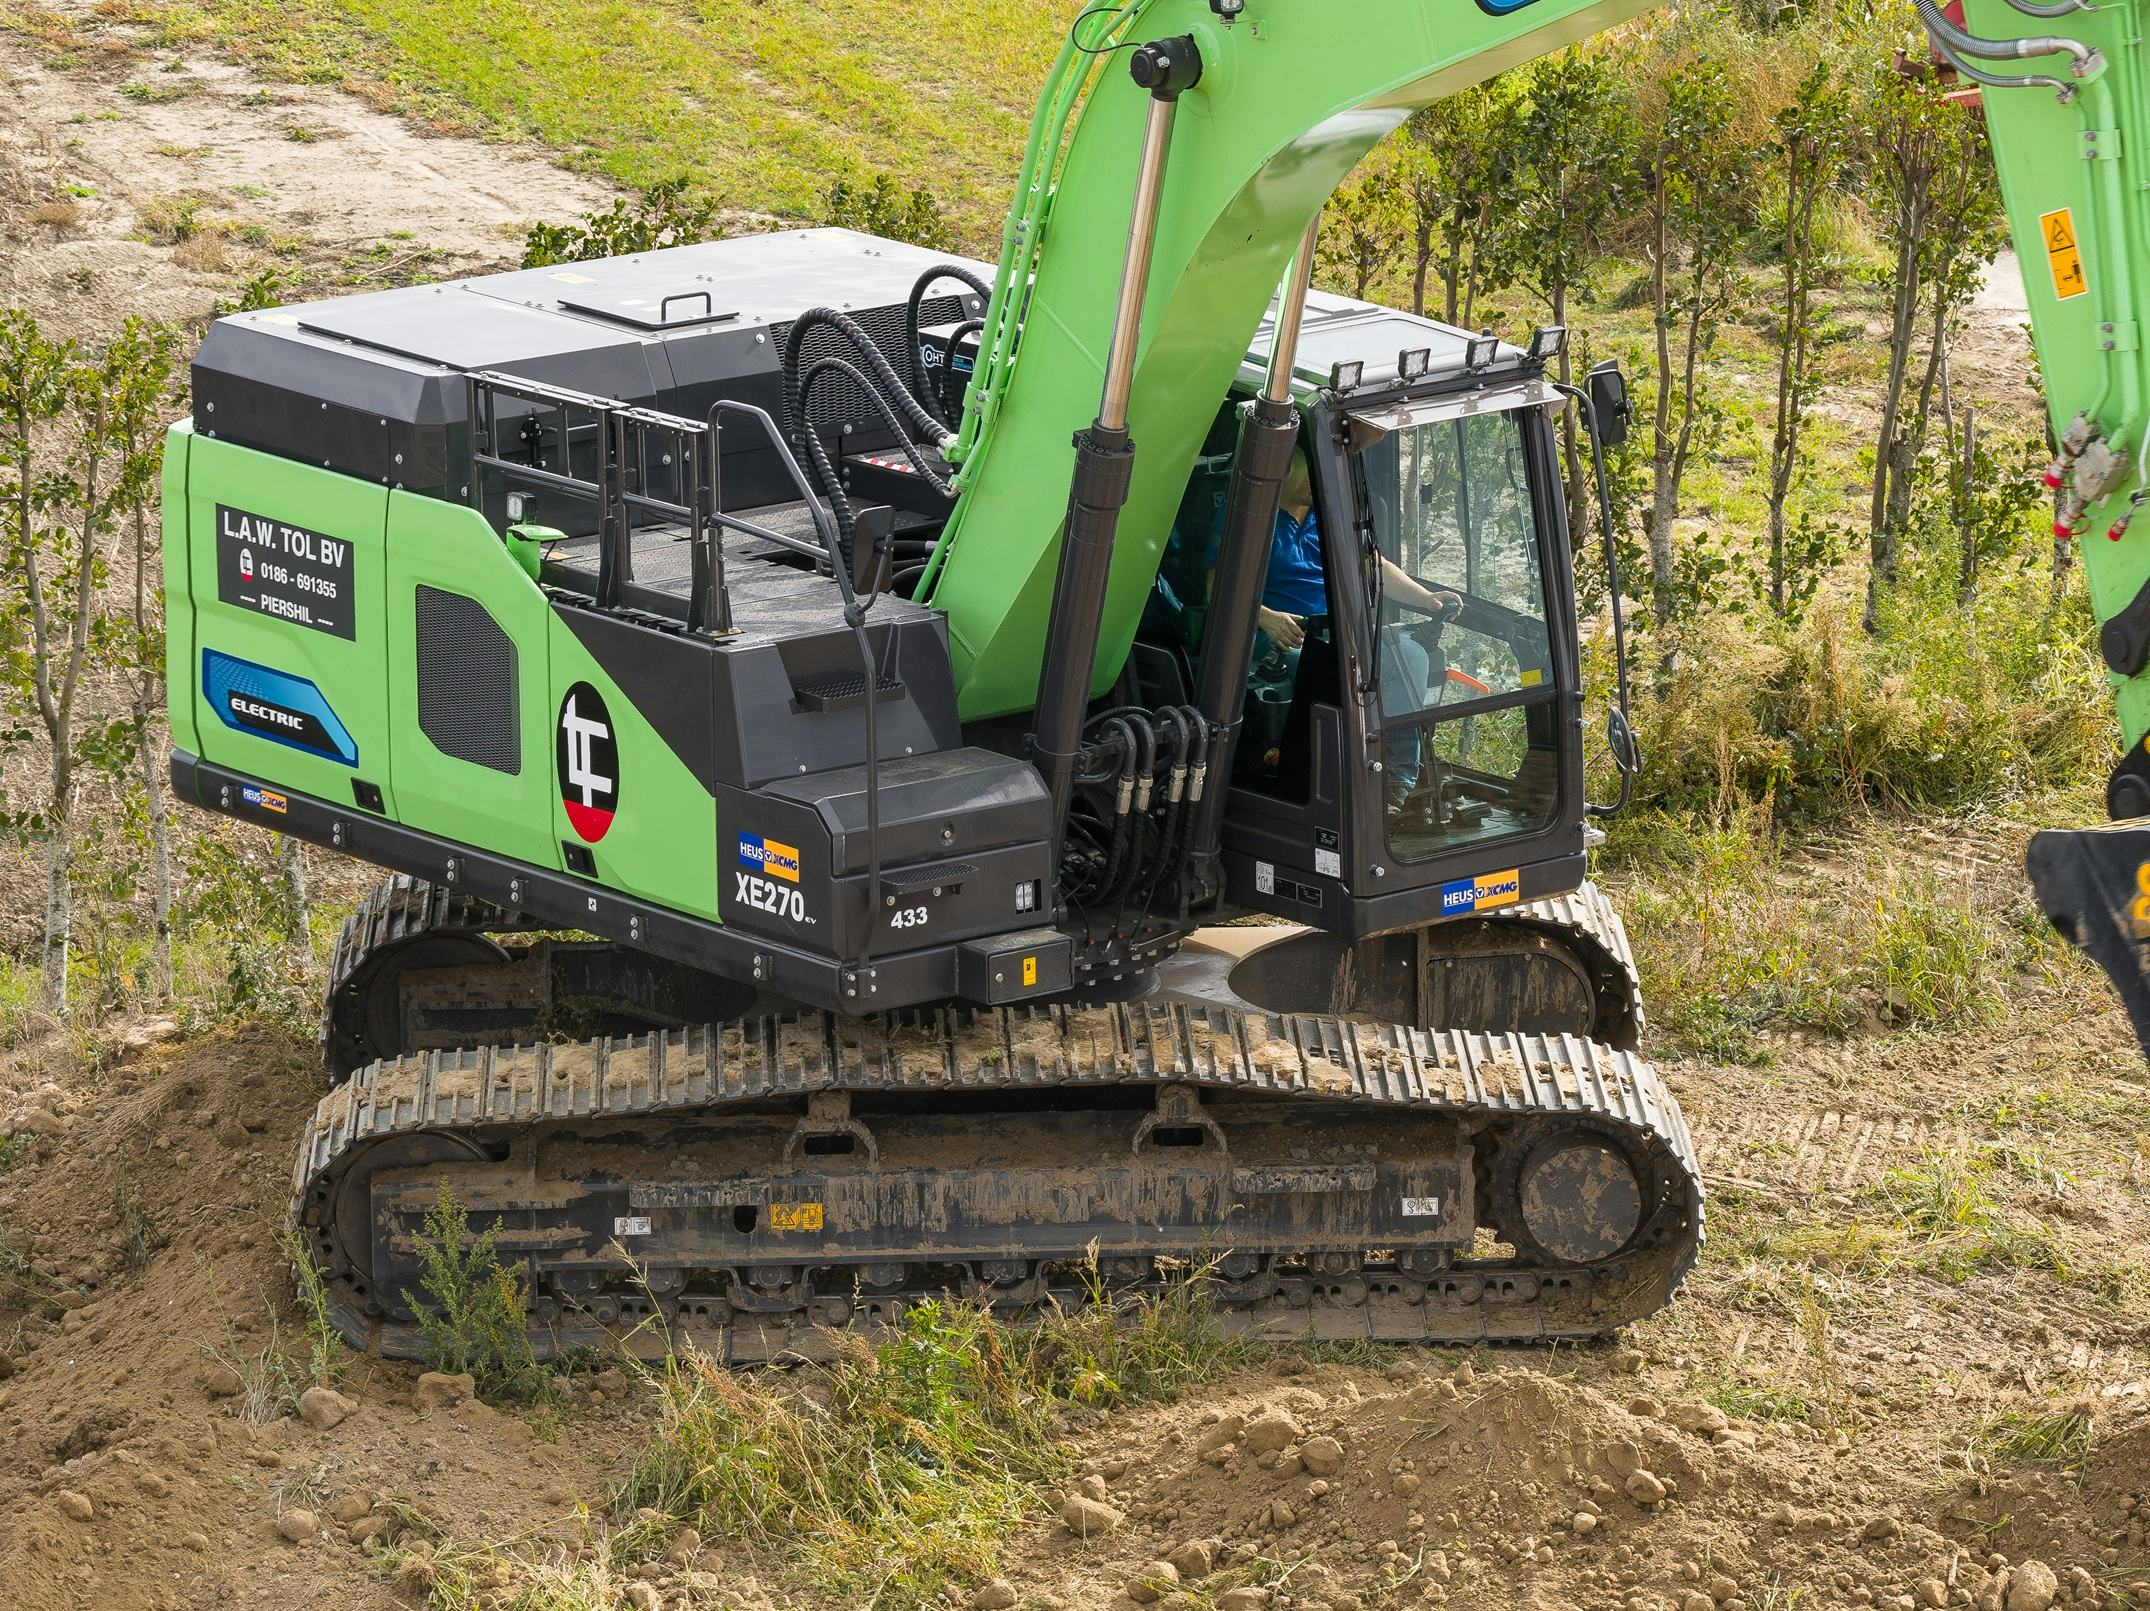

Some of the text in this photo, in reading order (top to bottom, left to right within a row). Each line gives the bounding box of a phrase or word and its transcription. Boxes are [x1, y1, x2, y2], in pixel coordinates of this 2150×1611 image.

[224, 511, 344, 568] L.A.W. TOL BV
[260, 562, 288, 584] 0186
[297, 572, 337, 599] 691355
[261, 594, 313, 624] PIERSHIL
[231, 697, 303, 731] ELECTRIC
[243, 787, 261, 803] HEUS
[740, 841, 798, 871] HEUS XCMG
[1443, 880, 1518, 906] HEUS XCMG
[890, 906, 929, 929] 433
